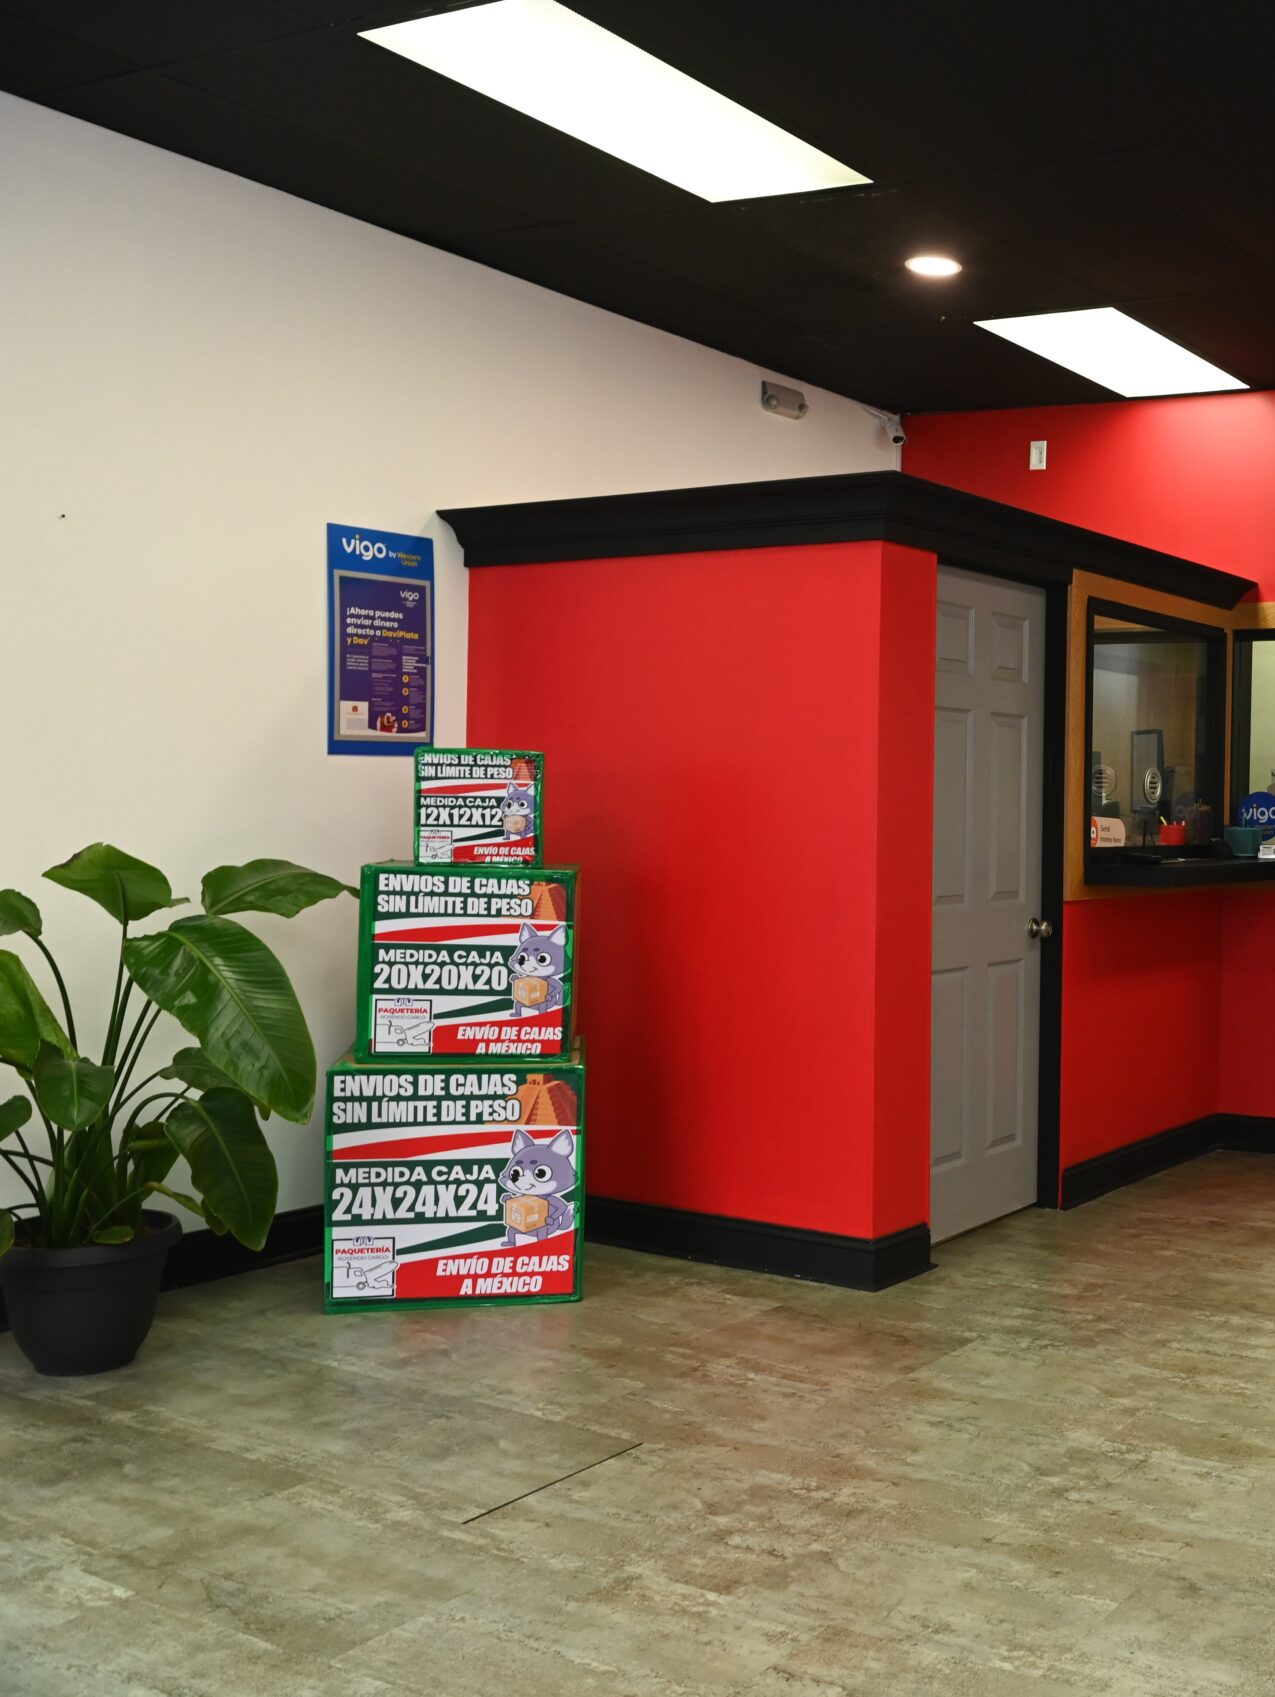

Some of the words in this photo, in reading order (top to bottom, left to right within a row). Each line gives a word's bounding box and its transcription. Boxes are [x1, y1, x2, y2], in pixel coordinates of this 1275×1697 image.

[342, 534, 386, 560] vigo
[389, 550, 396, 559] by
[400, 590, 419, 600] vigo
[347, 607, 373, 615] ¡Ahora
[374, 619, 398, 628] dinero
[347, 626, 374, 635] directo
[382, 630, 418, 639] DaviPlata
[420, 754, 458, 764] ENVIOS
[461, 754, 474, 764] DE
[477, 754, 510, 765] CAJAS
[419, 766, 435, 777] SIN
[437, 764, 470, 778] LÍMITE
[473, 767, 486, 778] DE
[487, 767, 512, 778] PESO
[420, 807, 502, 825] 12X12X12
[474, 846, 498, 855] ENVÍO
[378, 873, 445, 892] ENVIOS
[449, 877, 471, 893] DE
[475, 878, 530, 895] CAJAS
[378, 895, 406, 913] SIN
[410, 893, 464, 914] LÍMITE
[467, 898, 488, 915] DE
[491, 898, 532, 916] PESO
[379, 950, 450, 962] MEDIDA
[454, 951, 504, 963] CAJA
[374, 964, 508, 990] 20X20X20
[457, 1025, 499, 1040] ENVÍO
[501, 1027, 518, 1040] DE
[520, 1027, 562, 1040] CAJAS
[476, 1043, 487, 1055] A
[489, 1041, 541, 1055] MÉXICO
[334, 1075, 413, 1097] ENVIOS
[418, 1075, 445, 1096] DE
[450, 1074, 517, 1096] CAJAS
[332, 1101, 367, 1123] SIN
[372, 1098, 437, 1122] LÍMITE
[441, 1101, 467, 1122] DE
[470, 1100, 520, 1121] PESO
[336, 1167, 427, 1184] MEDIDA
[431, 1165, 495, 1182] CAJA
[332, 1184, 498, 1221] 24X24X24
[335, 1246, 390, 1255] PAQUETERÍA
[437, 1256, 489, 1276] ENVÍO
[491, 1258, 514, 1274] DE
[516, 1256, 570, 1273] CAJAS
[460, 1280, 472, 1295] A
[475, 1275, 543, 1294] MÉXICO
